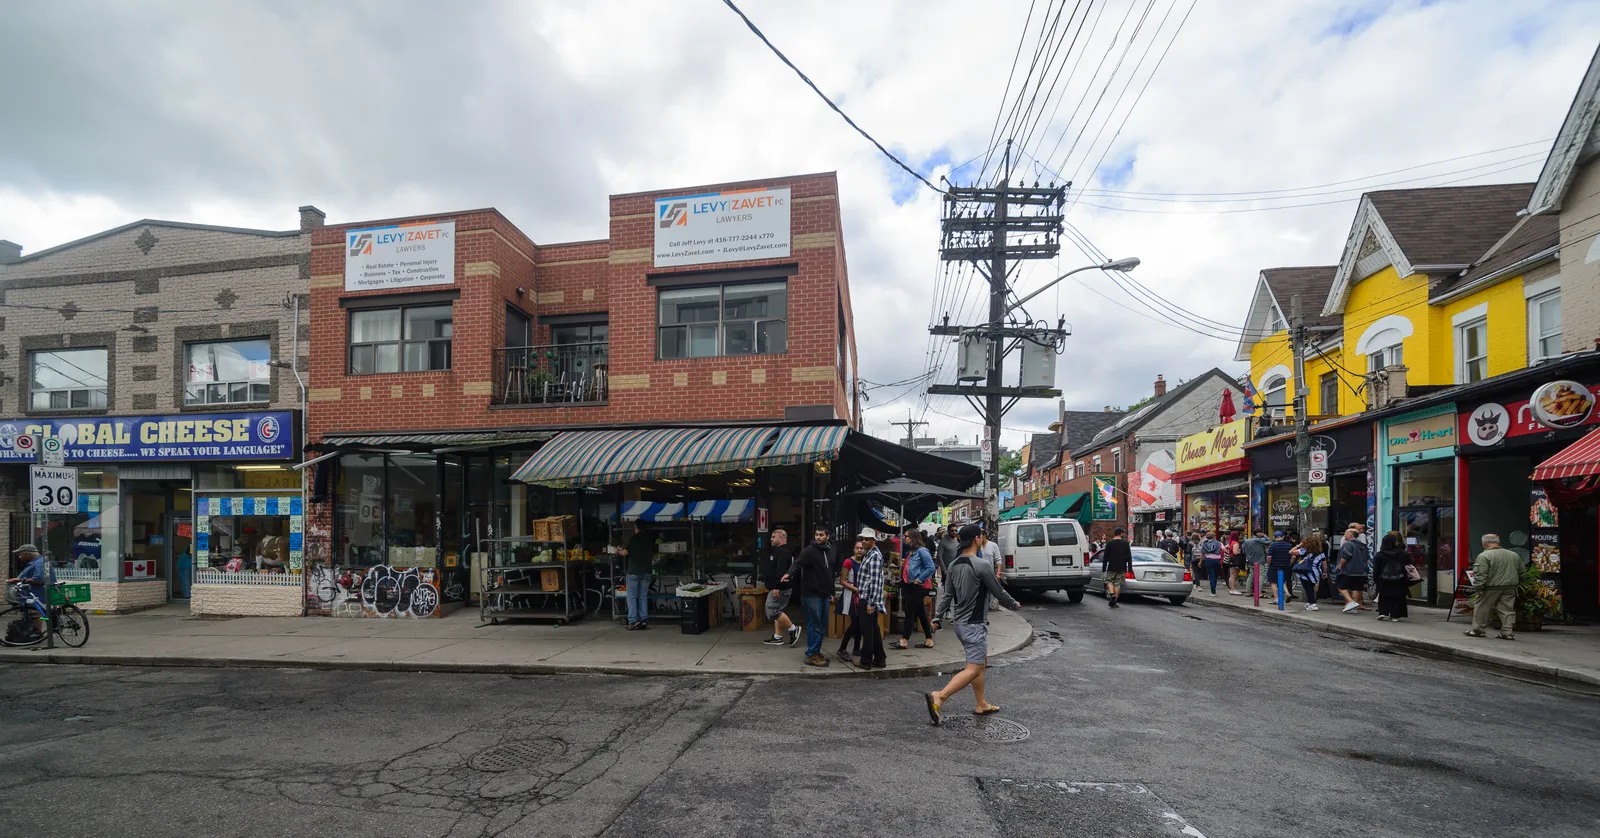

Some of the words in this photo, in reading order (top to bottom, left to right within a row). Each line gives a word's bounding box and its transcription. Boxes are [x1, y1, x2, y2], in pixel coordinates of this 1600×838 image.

[693, 200, 728, 214] LEVY
[731, 196, 774, 211] ZAVET
[716, 214, 753, 224] LAWYERS
[377, 233, 404, 244] LEVY
[408, 229, 441, 241] ZAVET
[693, 239, 706, 247] Levy
[715, 234, 757, 243] 416-777-2244
[396, 245, 426, 253] LAWYERS
[656, 249, 714, 259] www.LevyZavet.com
[722, 243, 787, 253] JLevy@LevyZavet.com
[140, 418, 250, 444] CHEESE
[1389, 437, 1409, 446] One
[1421, 426, 1453, 440] Heart
[71, 448, 85, 458] TO
[140, 448, 156, 457] WE
[157, 447, 191, 457] SPEAK
[191, 446, 221, 456] YOUR
[1180, 442, 1207, 464] Cheese
[1210, 429, 1238, 458] Magic
[38, 485, 73, 506] 30
[1535, 534, 1558, 542] POUTINE
